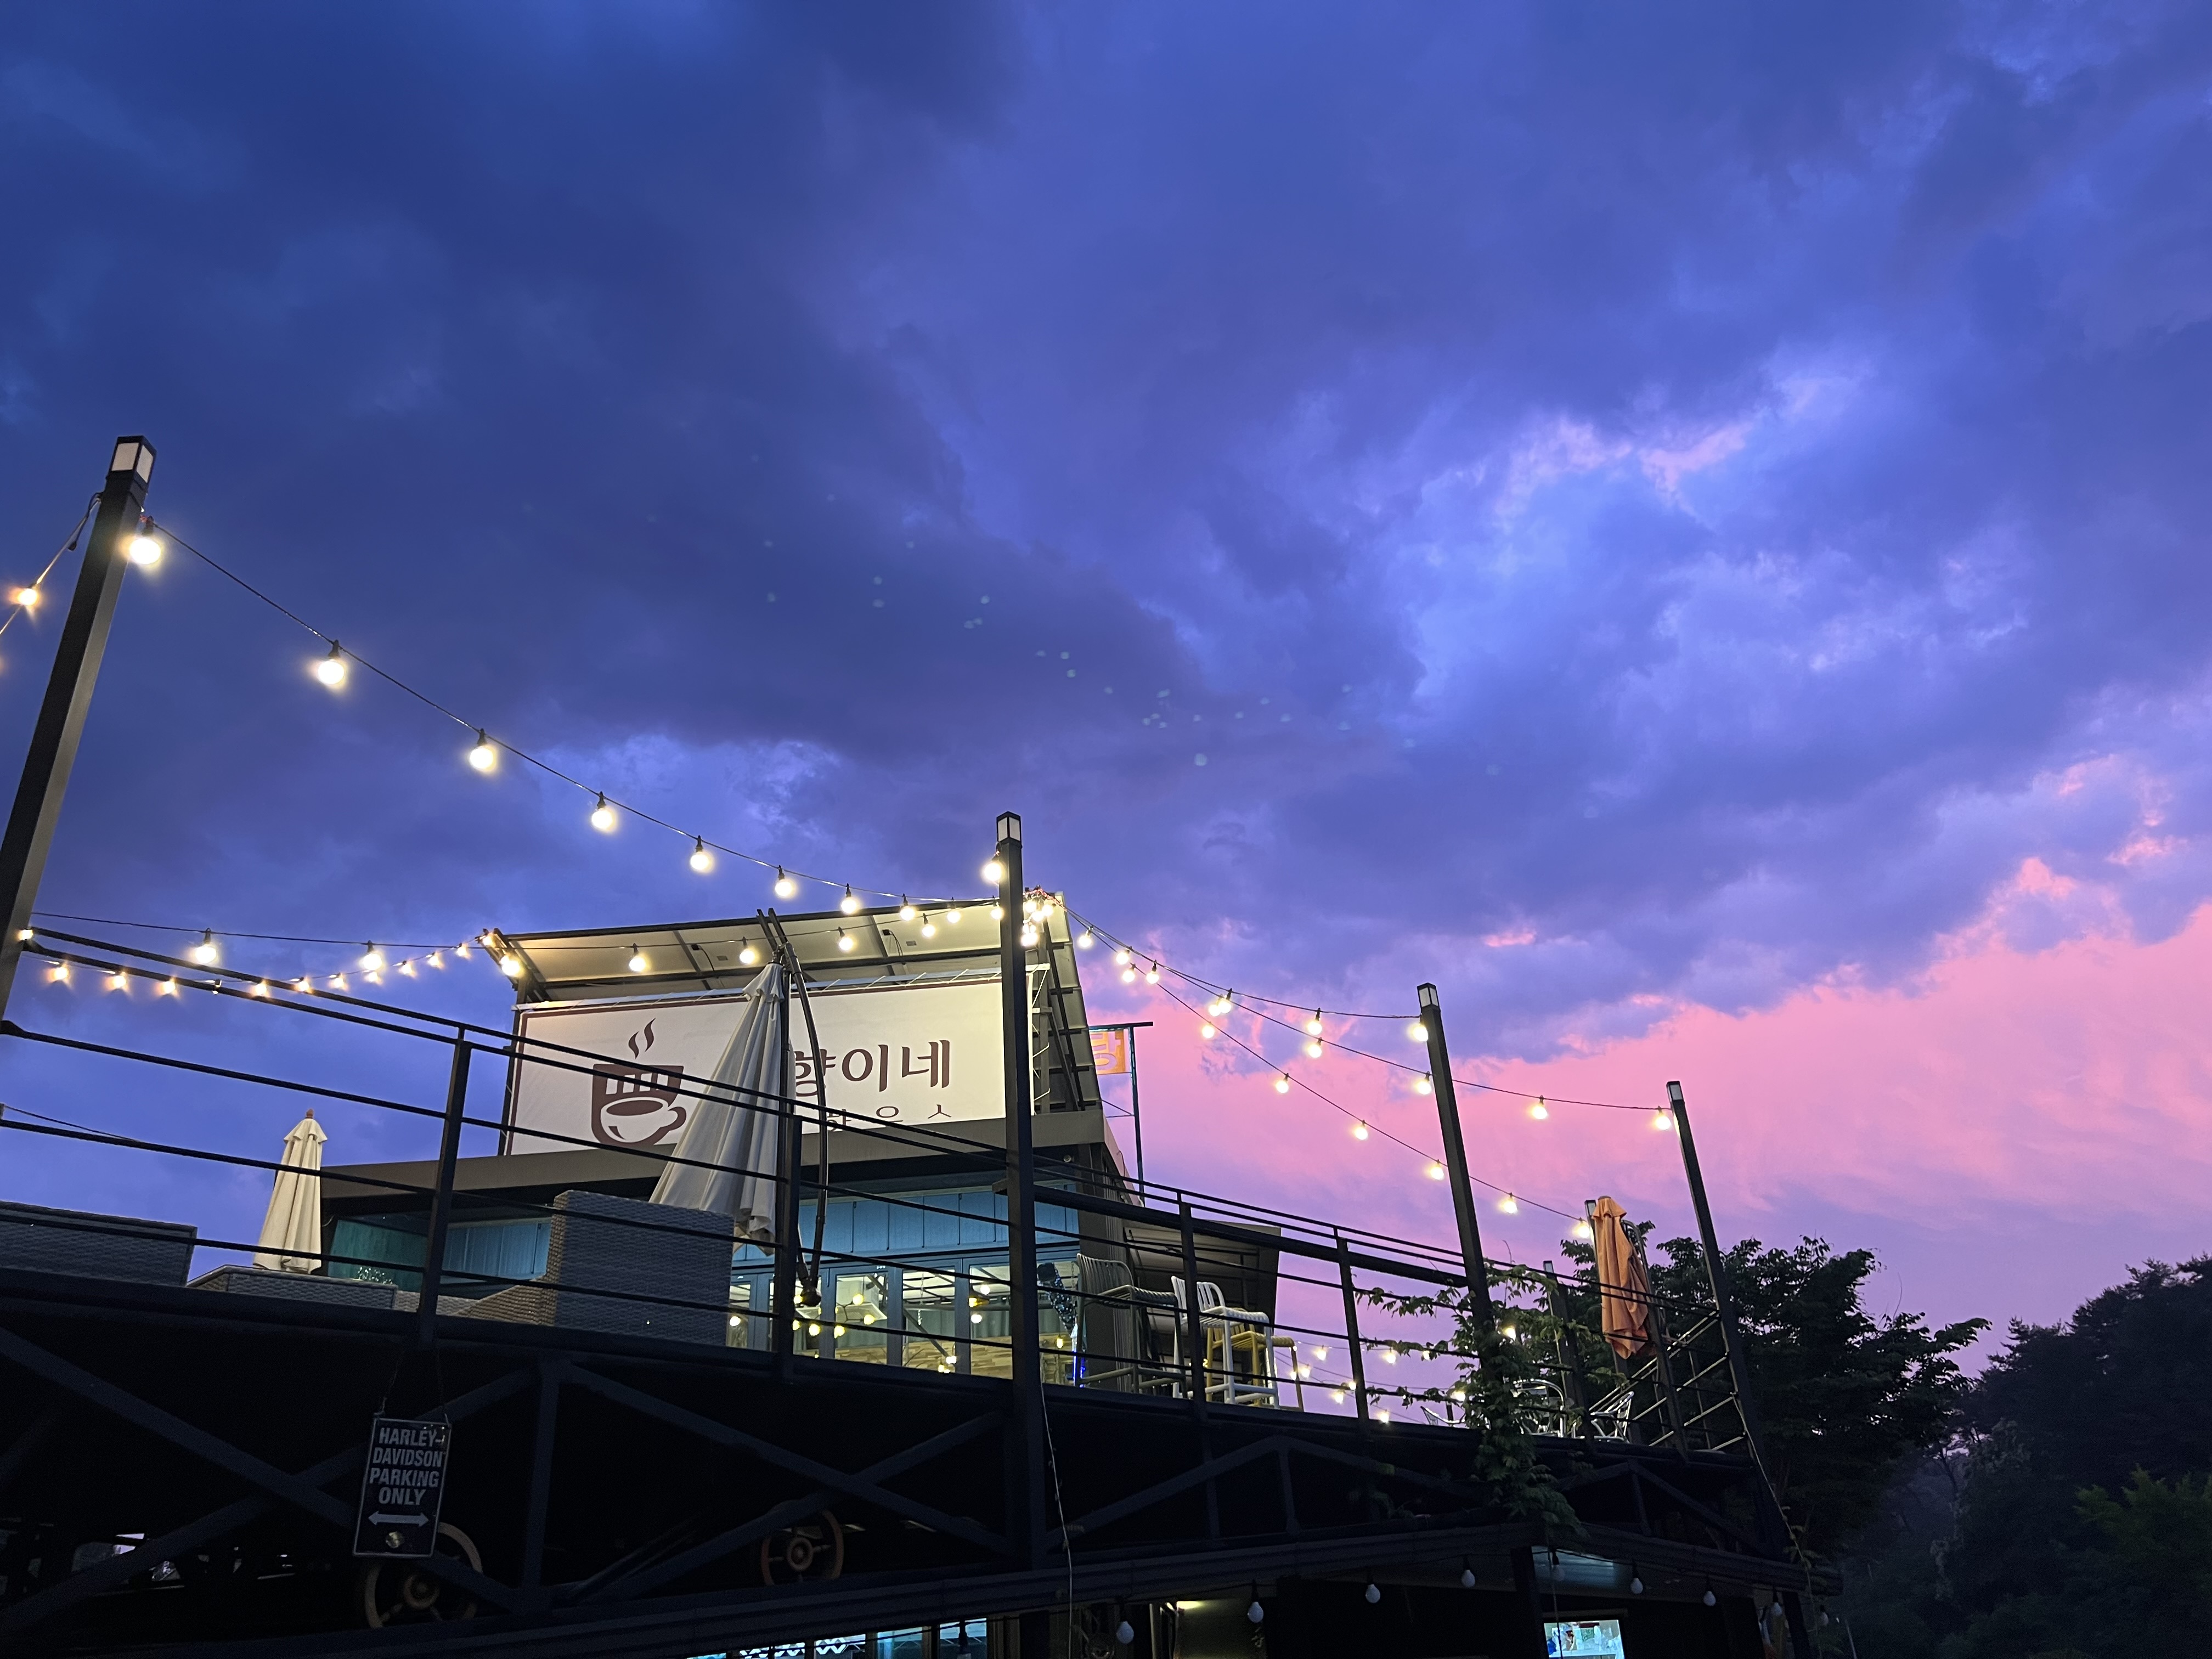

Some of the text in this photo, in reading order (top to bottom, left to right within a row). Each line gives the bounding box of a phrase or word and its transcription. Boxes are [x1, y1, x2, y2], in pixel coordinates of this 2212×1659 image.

[379, 1427, 442, 1447] HARLEY-
[373, 1447, 443, 1468] DAVIDSON
[369, 1468, 440, 1487] PARKING
[379, 1487, 426, 1505] ONLY
